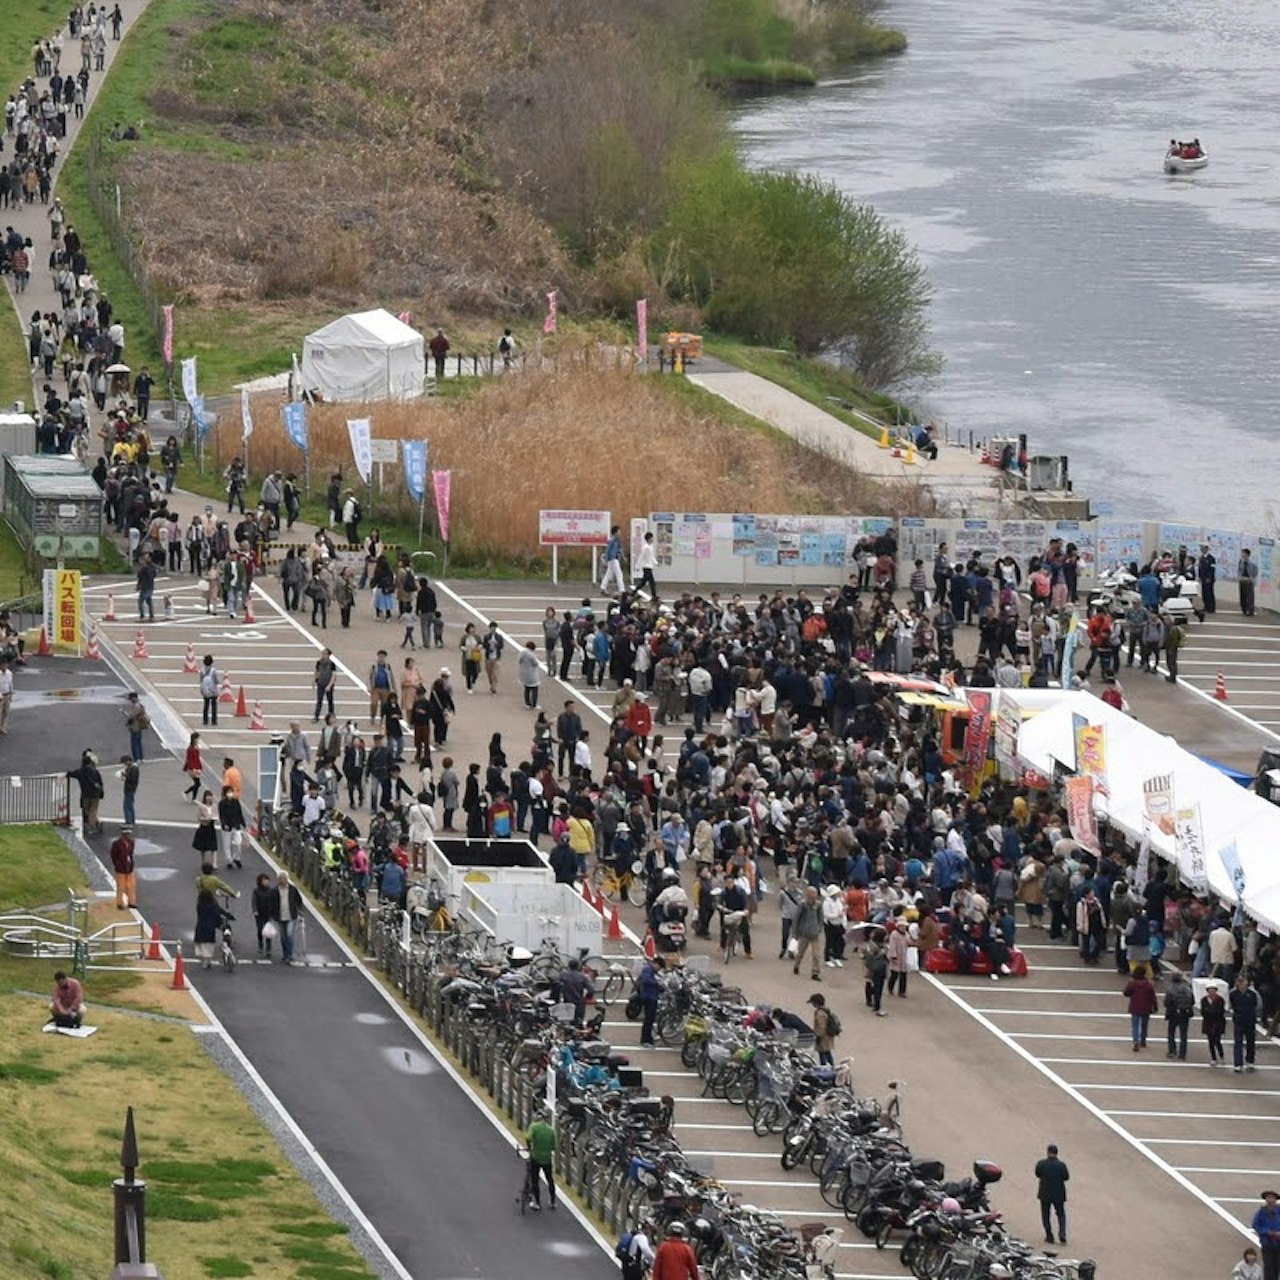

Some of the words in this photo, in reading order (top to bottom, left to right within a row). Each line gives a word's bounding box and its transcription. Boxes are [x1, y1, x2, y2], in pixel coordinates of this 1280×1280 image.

[60, 572, 76, 642] バス転回場
